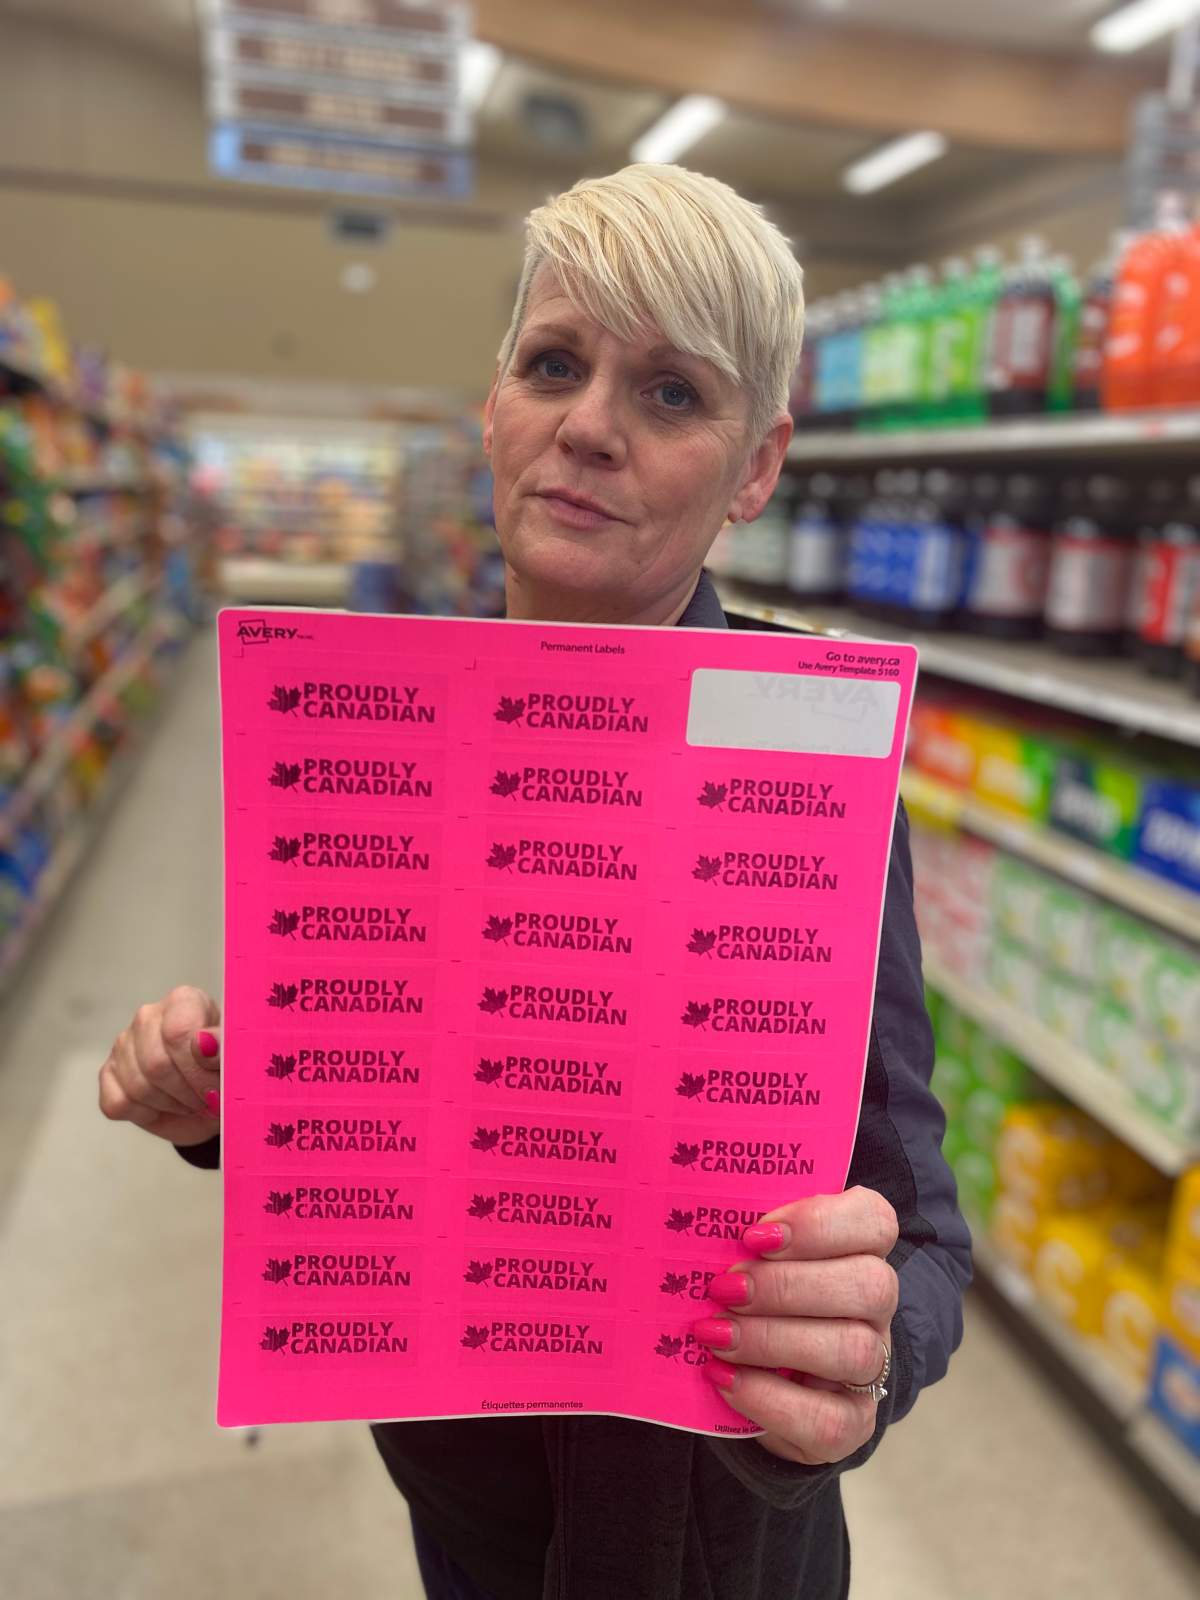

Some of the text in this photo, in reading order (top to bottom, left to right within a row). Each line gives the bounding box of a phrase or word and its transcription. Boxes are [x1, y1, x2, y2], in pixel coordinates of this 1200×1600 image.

[236, 626, 298, 639] AVERY
[540, 641, 625, 655] Permanent Labels
[798, 661, 900, 677] Use Avery Template 5160
[826, 651, 900, 668] Go to avery.ca
[303, 681, 419, 705] PROUDLY
[303, 700, 435, 724] CANADIAN
[526, 693, 635, 714] PROUDLY
[526, 711, 649, 733] CANADIAN
[303, 758, 417, 779] PROUDLY
[523, 767, 629, 788] PROUDLY
[303, 775, 433, 798] CANADIAN
[522, 784, 643, 807] CANADIAN
[728, 778, 833, 801] PROUDLY
[728, 796, 847, 819] CANADIAN
[303, 832, 414, 853] PROUDLY
[517, 839, 624, 862] PROUDLY
[302, 850, 430, 871] CANADIAN
[517, 857, 638, 881] CANADIAN
[724, 851, 825, 873] PROUDLY
[722, 869, 838, 891] CANADIAN
[302, 905, 412, 925] PROUDLY
[513, 911, 619, 935] PROUDLY
[301, 923, 427, 943] CANADIAN
[513, 930, 632, 954] CANADIAN
[716, 925, 819, 945] PROUDLY
[716, 942, 832, 963] CANADIAN
[300, 978, 409, 997] PROUDLY
[510, 984, 614, 1008] PROUDLY
[299, 995, 423, 1014] CANADIAN
[508, 1002, 627, 1026] CANADIAN
[711, 997, 813, 1018] PROUDLY
[711, 1015, 826, 1035] CANADIAN
[298, 1049, 405, 1067] PROUDLY
[504, 1055, 609, 1079] PROUDLY
[297, 1066, 420, 1084] CANADIAN
[504, 1072, 622, 1097] CANADIAN
[706, 1069, 808, 1089] PROUDLY
[706, 1086, 821, 1106] CANADIAN
[297, 1119, 402, 1136] PROUDLY
[502, 1124, 604, 1147] PROUDLY
[296, 1135, 417, 1152] CANADIAN
[500, 1140, 617, 1164] CANADIAN
[702, 1139, 802, 1159] PROUDLY
[700, 1156, 815, 1176] CANADIAN
[294, 1187, 399, 1204] PROUDLY
[498, 1191, 599, 1213] PROUDLY
[294, 1203, 414, 1220] CANADIAN
[497, 1207, 612, 1230] CANADIAN
[696, 1207, 766, 1226] PROU
[294, 1254, 397, 1271] PROUDLY
[493, 1257, 594, 1277] PROUDLY
[292, 1270, 411, 1287] CANADIAN
[493, 1272, 608, 1293] CANADIAN
[290, 1321, 394, 1338] PROUDLY
[491, 1321, 590, 1339] PROUDLY
[290, 1337, 408, 1355] CANADIAN
[490, 1337, 603, 1355] CANADIAN
[481, 1400, 584, 1411] Étiquettes permanentes
